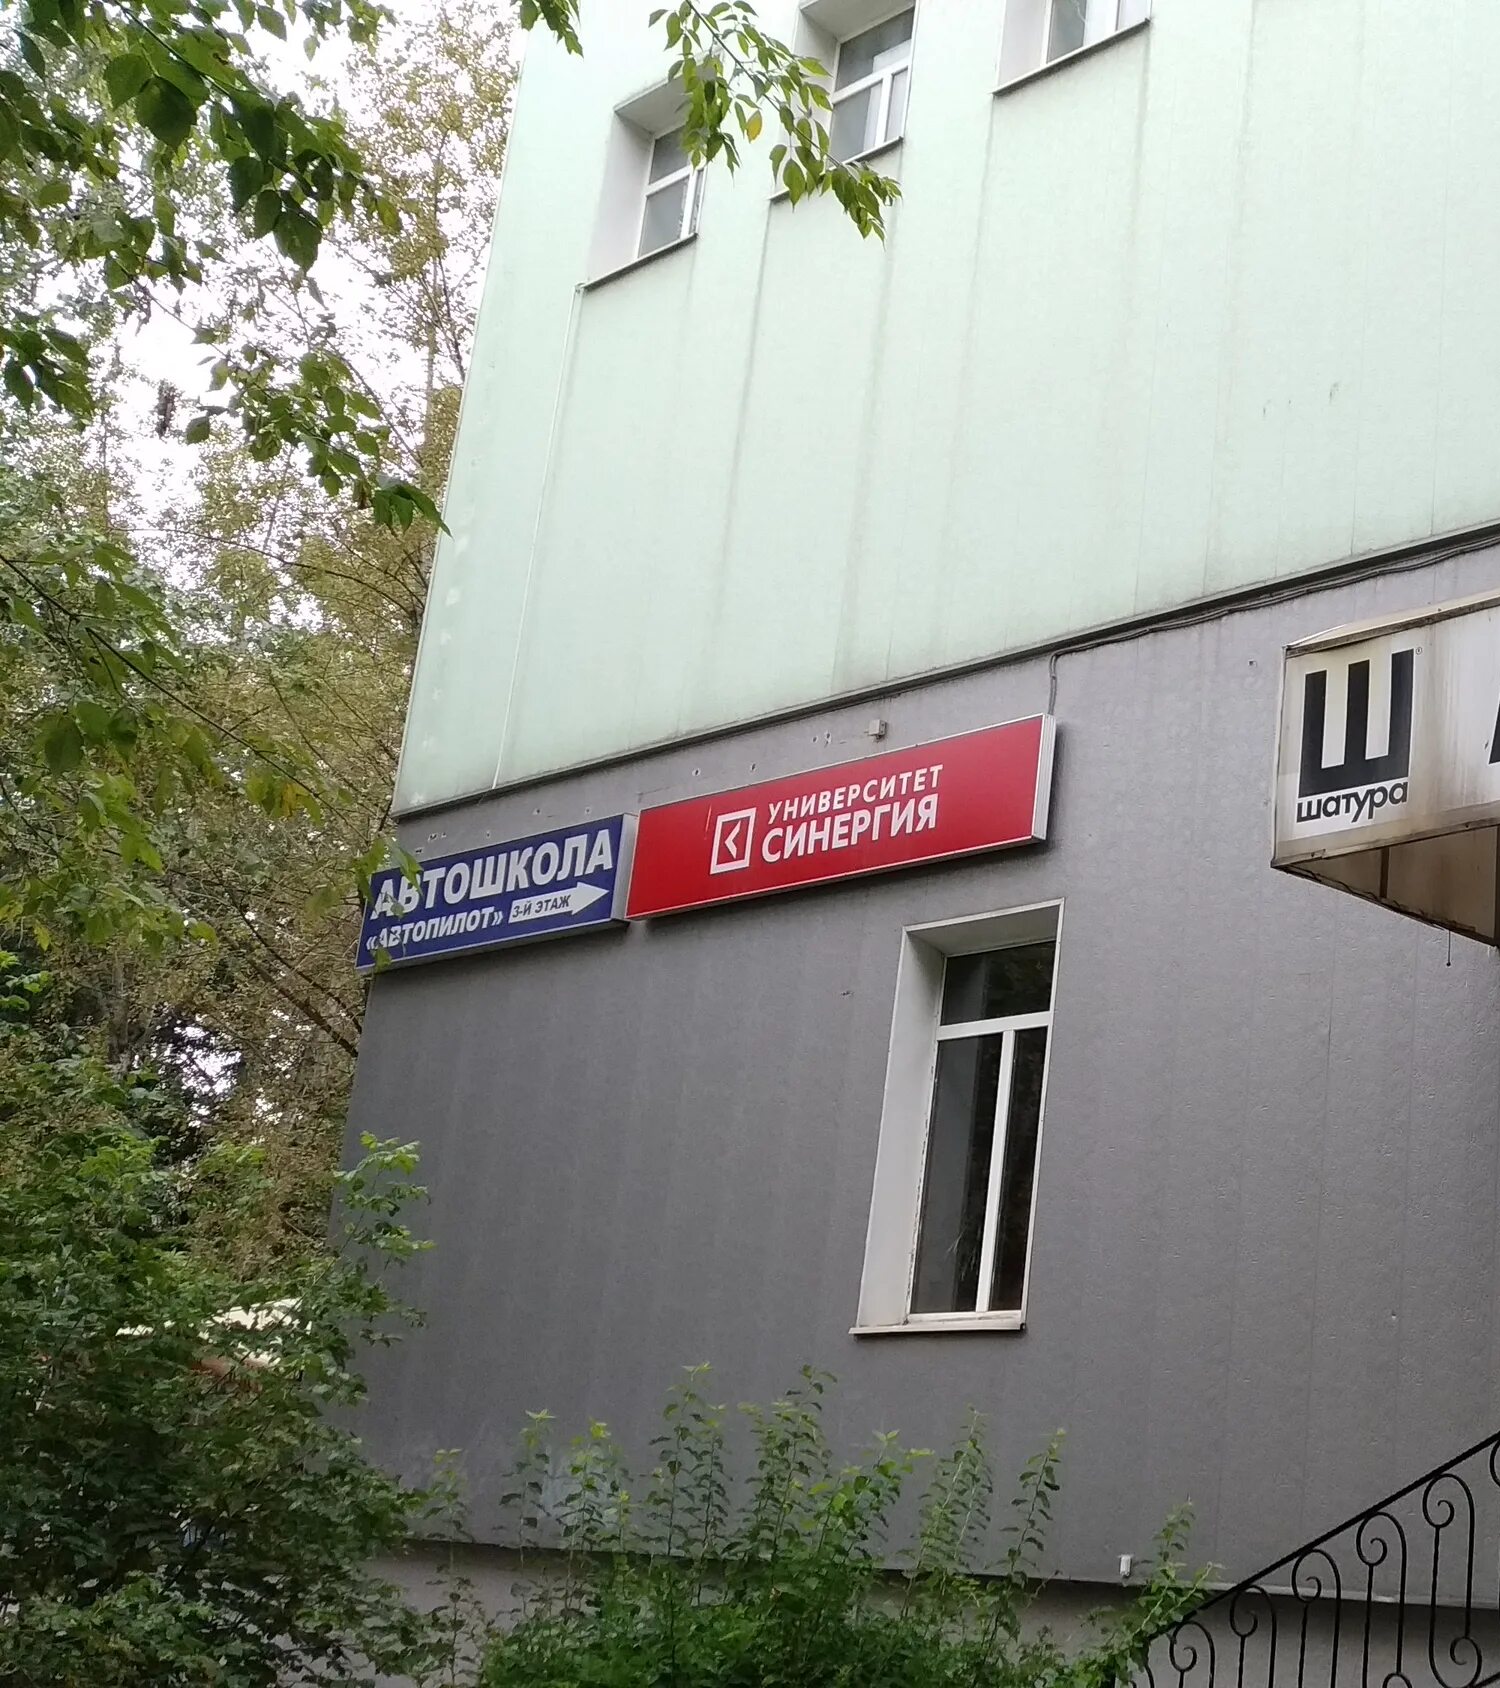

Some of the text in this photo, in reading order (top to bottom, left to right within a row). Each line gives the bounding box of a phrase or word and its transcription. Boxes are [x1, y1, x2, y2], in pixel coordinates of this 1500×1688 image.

[1298, 648, 1414, 798] Ш
[768, 764, 944, 825] УНИВЕРСИТЕТ
[1296, 781, 1408, 823] шатура
[761, 793, 939, 864] СИНЕРГИЯ
[370, 828, 613, 920] АВТОШКОЛА
[534, 895, 571, 915] ЭТАЖ
